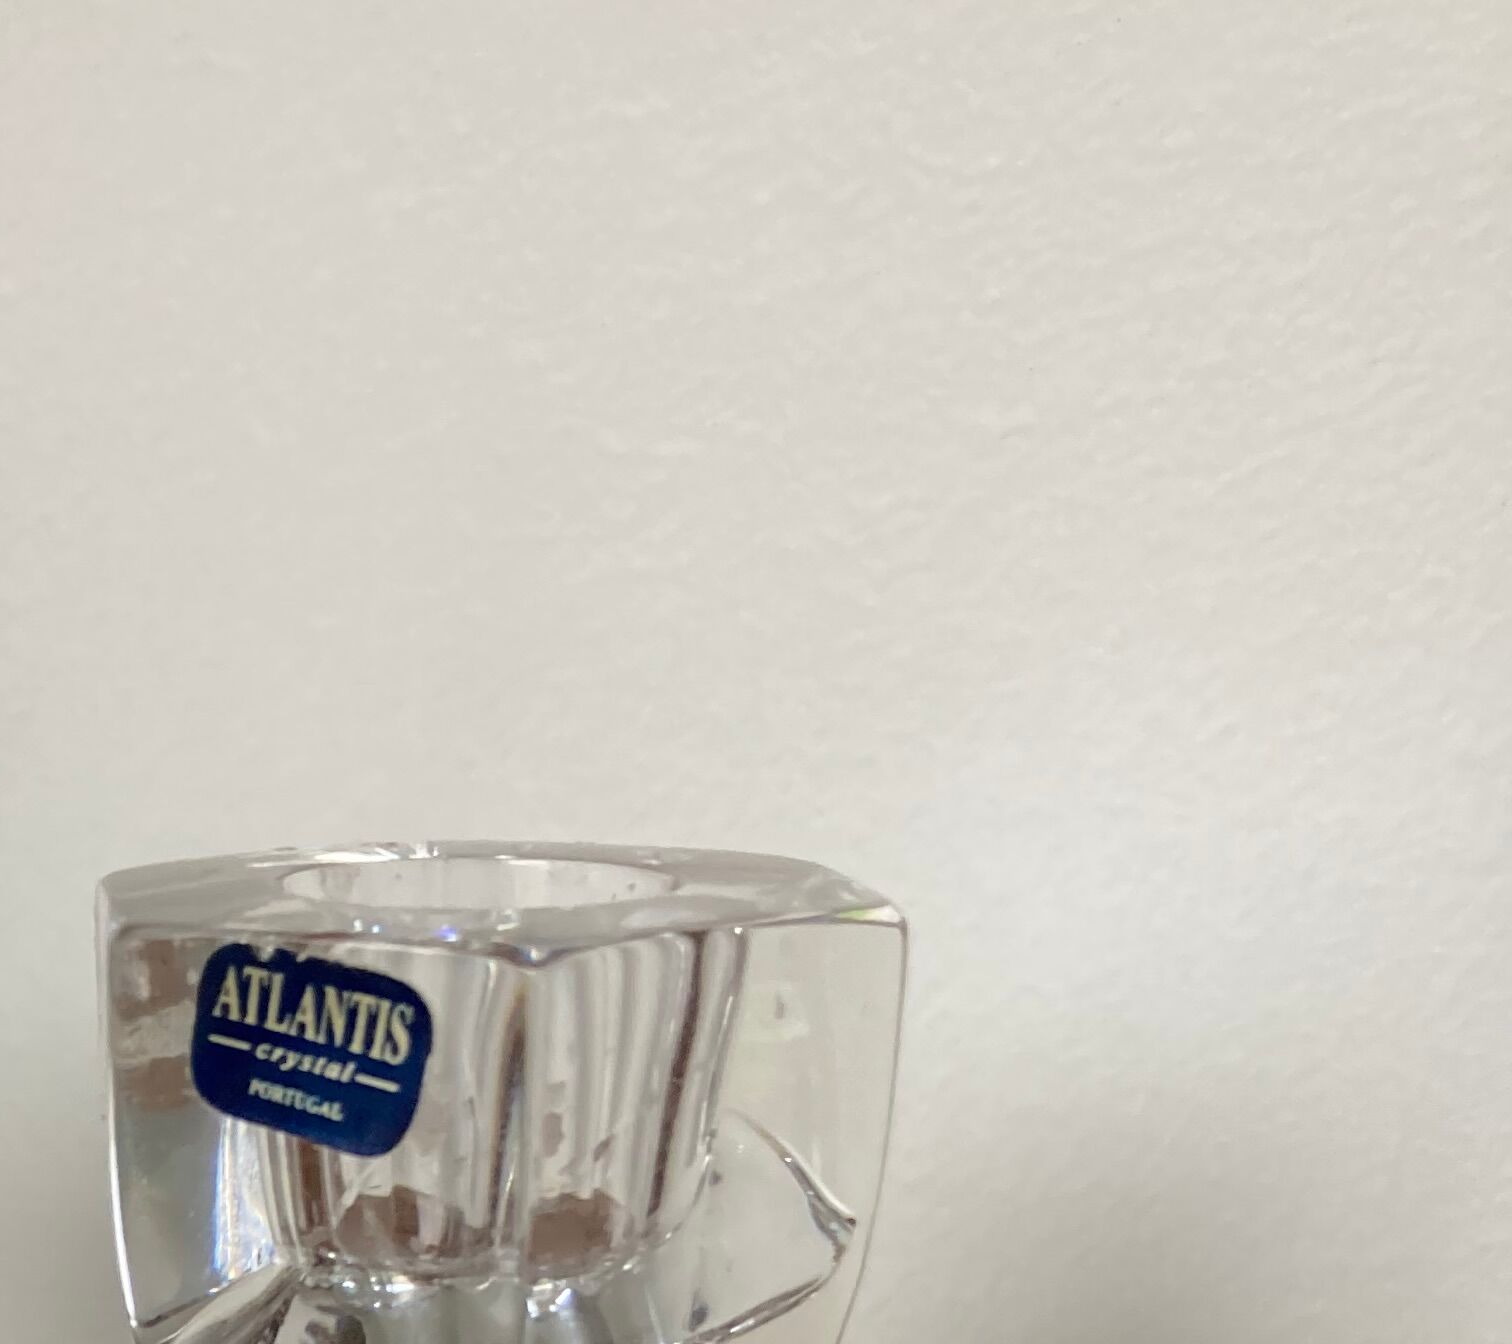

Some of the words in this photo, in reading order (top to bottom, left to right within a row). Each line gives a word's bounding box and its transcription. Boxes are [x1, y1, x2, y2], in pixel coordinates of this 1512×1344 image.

[211, 965, 415, 1066] ATLANTIS
[255, 1043, 357, 1083] crystal
[249, 1078, 344, 1121] PORTUGAL
